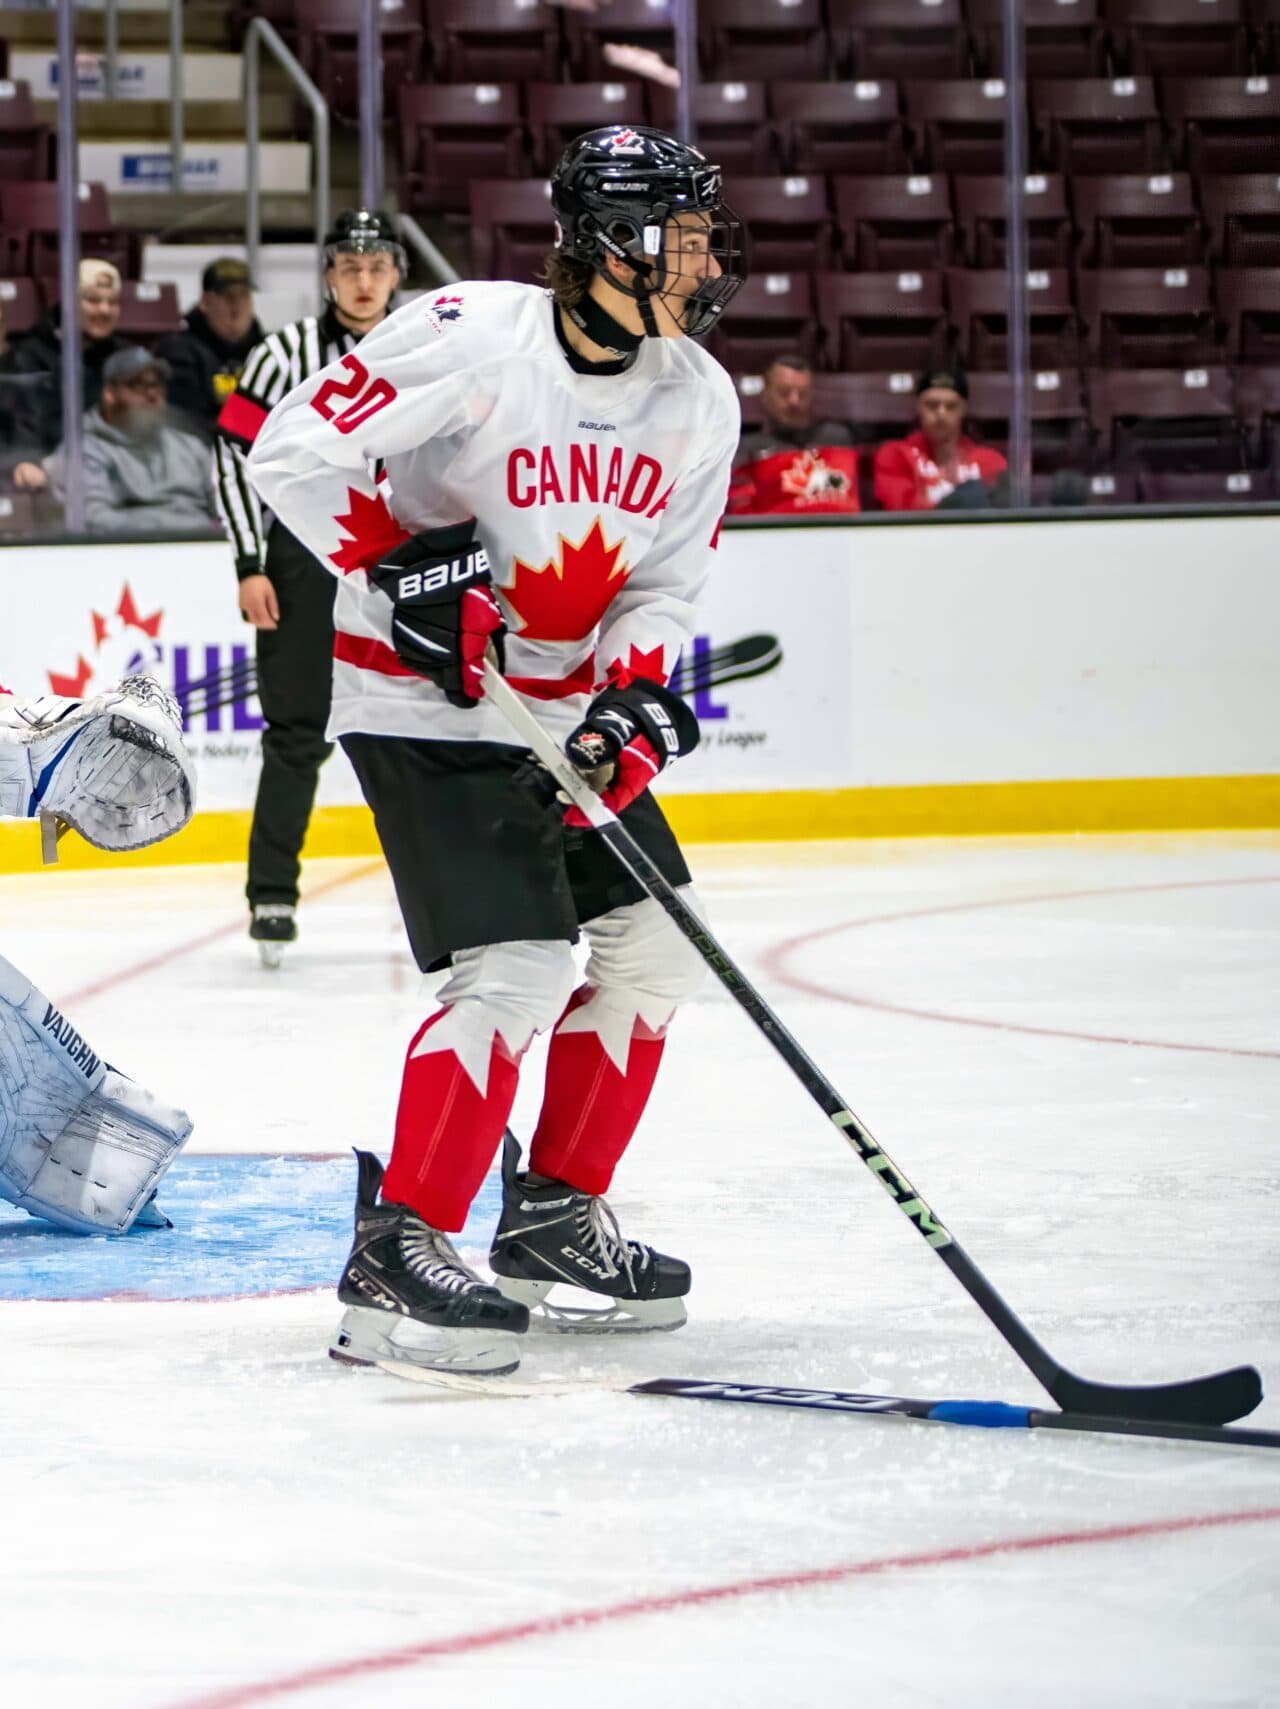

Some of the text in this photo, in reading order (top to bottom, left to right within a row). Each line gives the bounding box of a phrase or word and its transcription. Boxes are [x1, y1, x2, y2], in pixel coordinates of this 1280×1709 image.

[309, 353, 398, 435] 20
[398, 548, 491, 599] BAUE
[41, 1001, 101, 1079] VAUGHN
[830, 1110, 953, 1248] CCM
[559, 1245, 613, 1281] CCM
